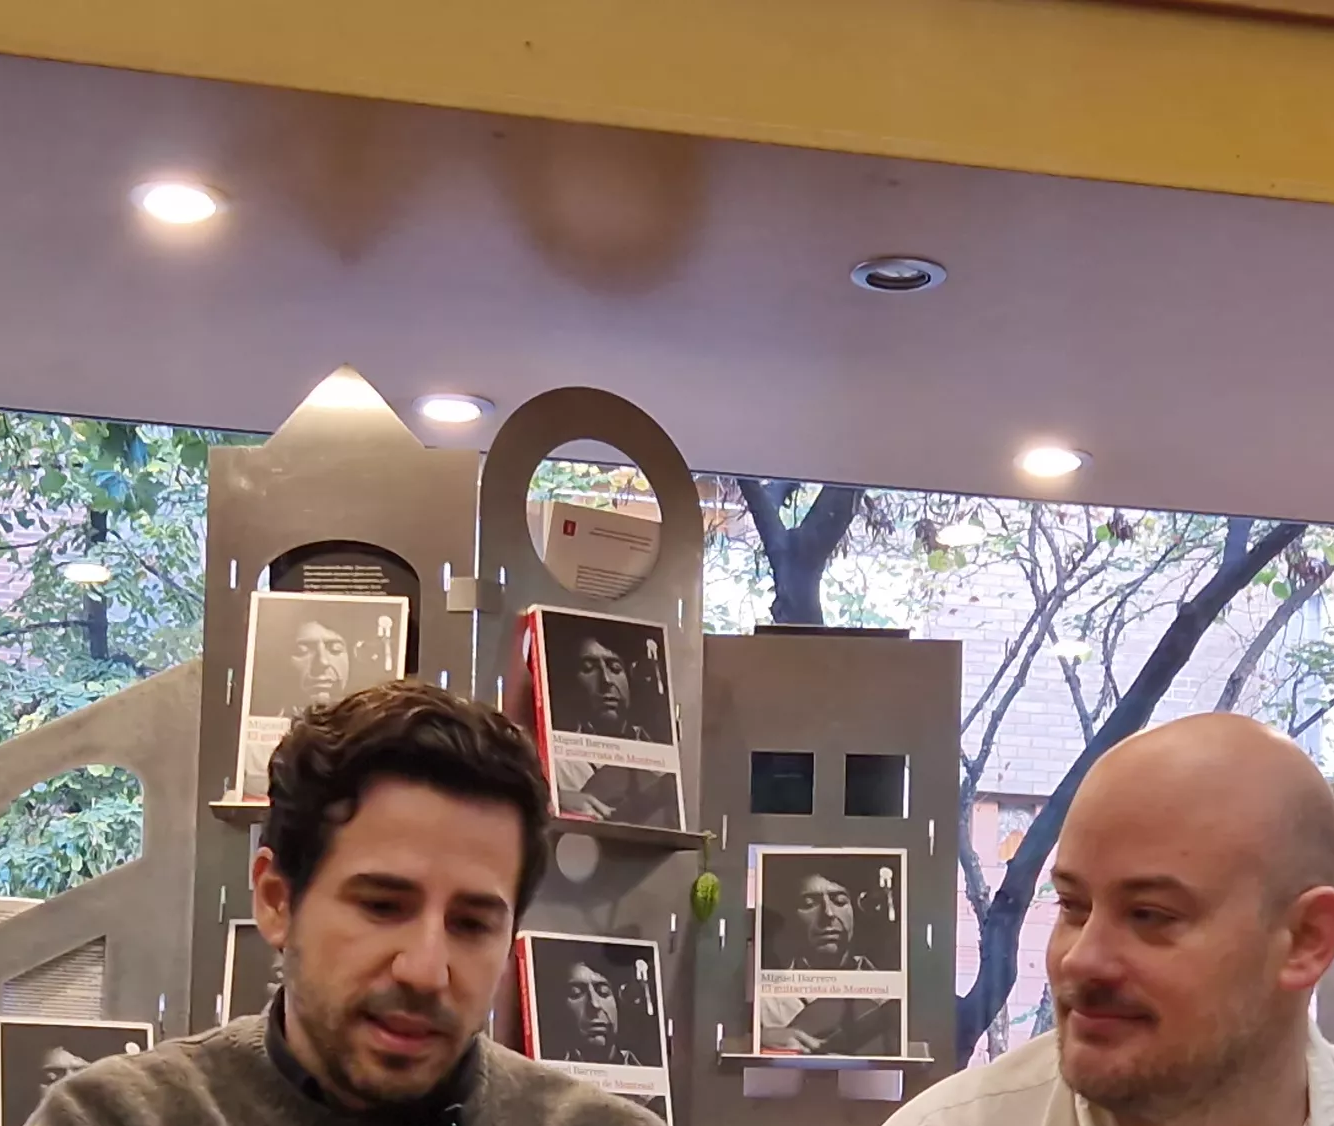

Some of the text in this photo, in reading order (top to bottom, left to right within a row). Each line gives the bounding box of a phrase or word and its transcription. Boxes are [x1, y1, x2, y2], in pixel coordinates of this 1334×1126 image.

[553, 734, 584, 746] Miguel
[626, 753, 665, 768] Montreal
[761, 974, 837, 984] Miguel Barrero
[773, 984, 827, 995] guitarrista
[830, 984, 841, 994] de
[844, 984, 888, 994] Montreal
[614, 1080, 654, 1091] Montreal
